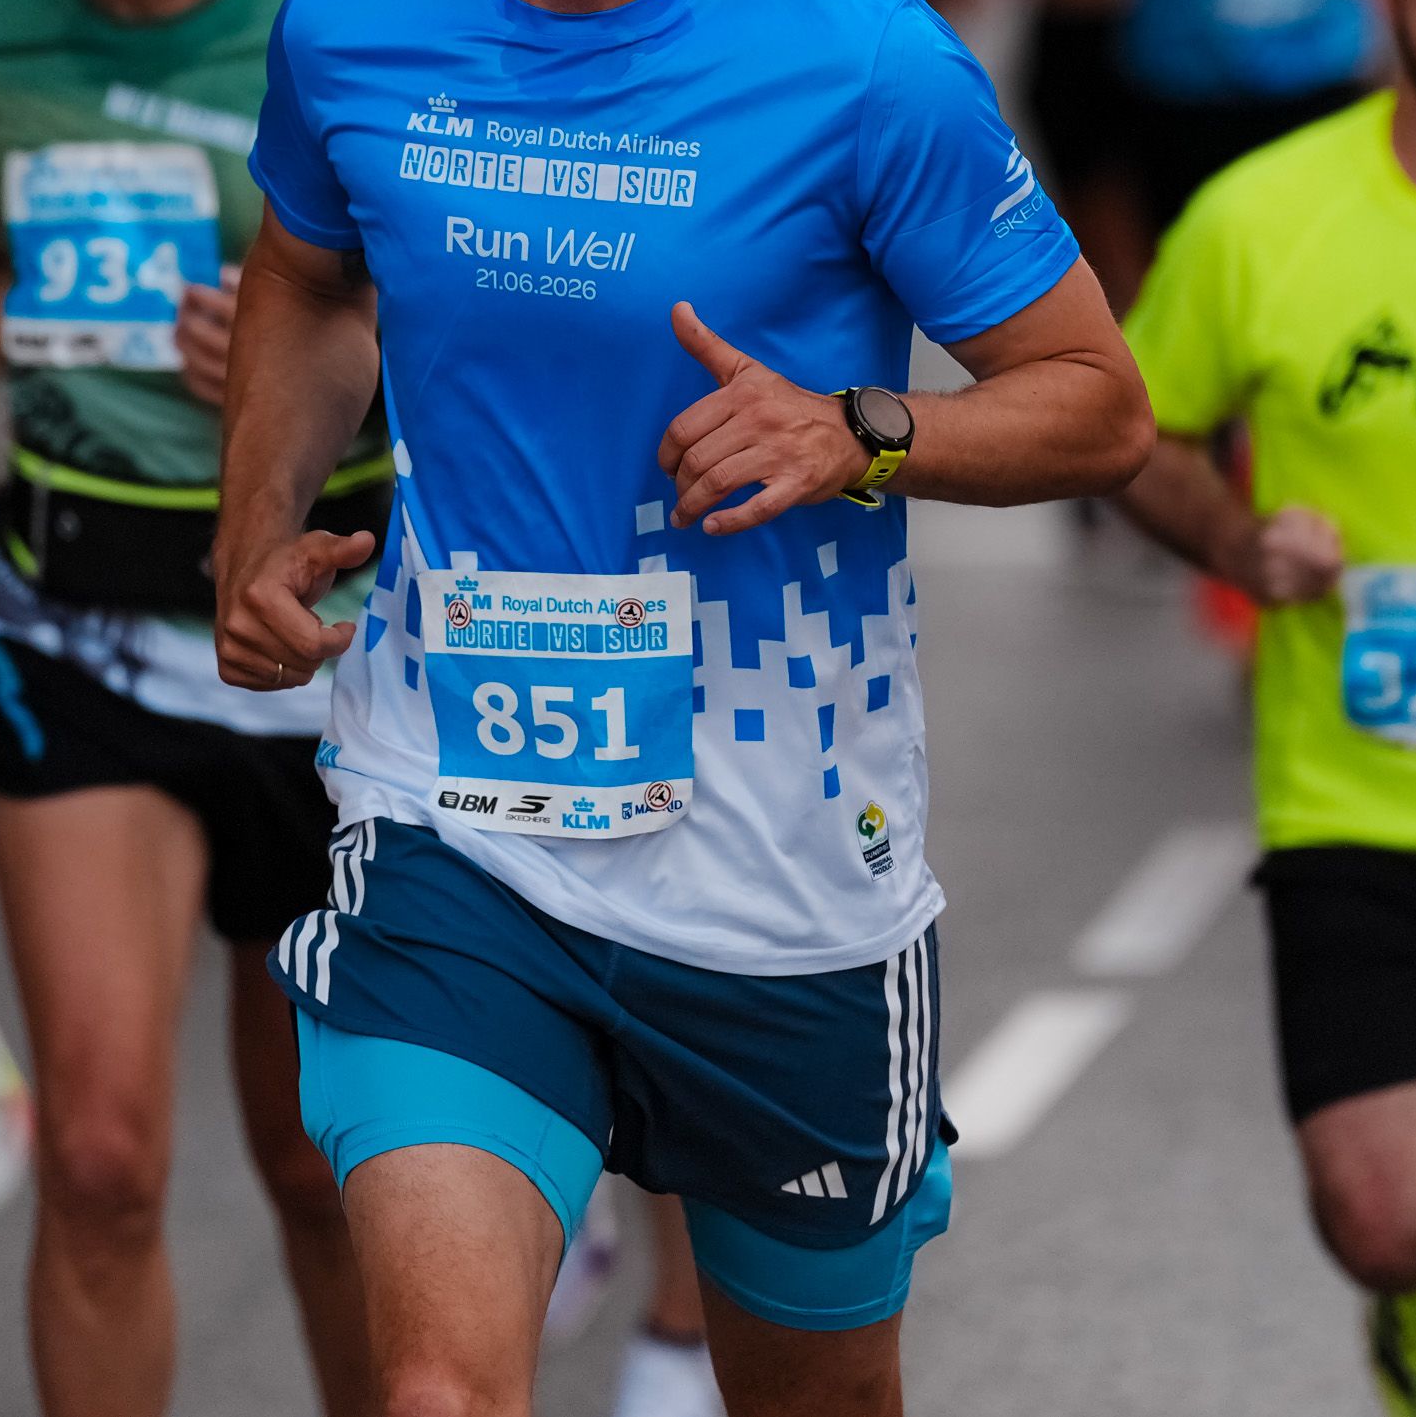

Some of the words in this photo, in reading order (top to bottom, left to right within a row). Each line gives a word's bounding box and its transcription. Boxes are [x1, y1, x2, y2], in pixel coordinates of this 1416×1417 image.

[406, 112, 474, 137] KLM
[485, 120, 543, 147] Royal
[548, 127, 611, 152] Dutch
[618, 133, 701, 158] Airlines
[403, 145, 520, 189] NORTE
[549, 161, 593, 196] VS
[623, 170, 694, 204] SUR
[445, 215, 529, 262] Run
[546, 226, 636, 272] Well
[38, 236, 182, 304] 934
[475, 267, 597, 301] 21.06.2026
[444, 593, 492, 610] KM
[502, 595, 543, 615] Royal
[547, 596, 593, 615] Dutch
[447, 621, 528, 648] NORTE
[552, 625, 583, 650] VS
[608, 623, 666, 650] SUR
[472, 681, 640, 761] 851
[561, 813, 611, 831] KLM
